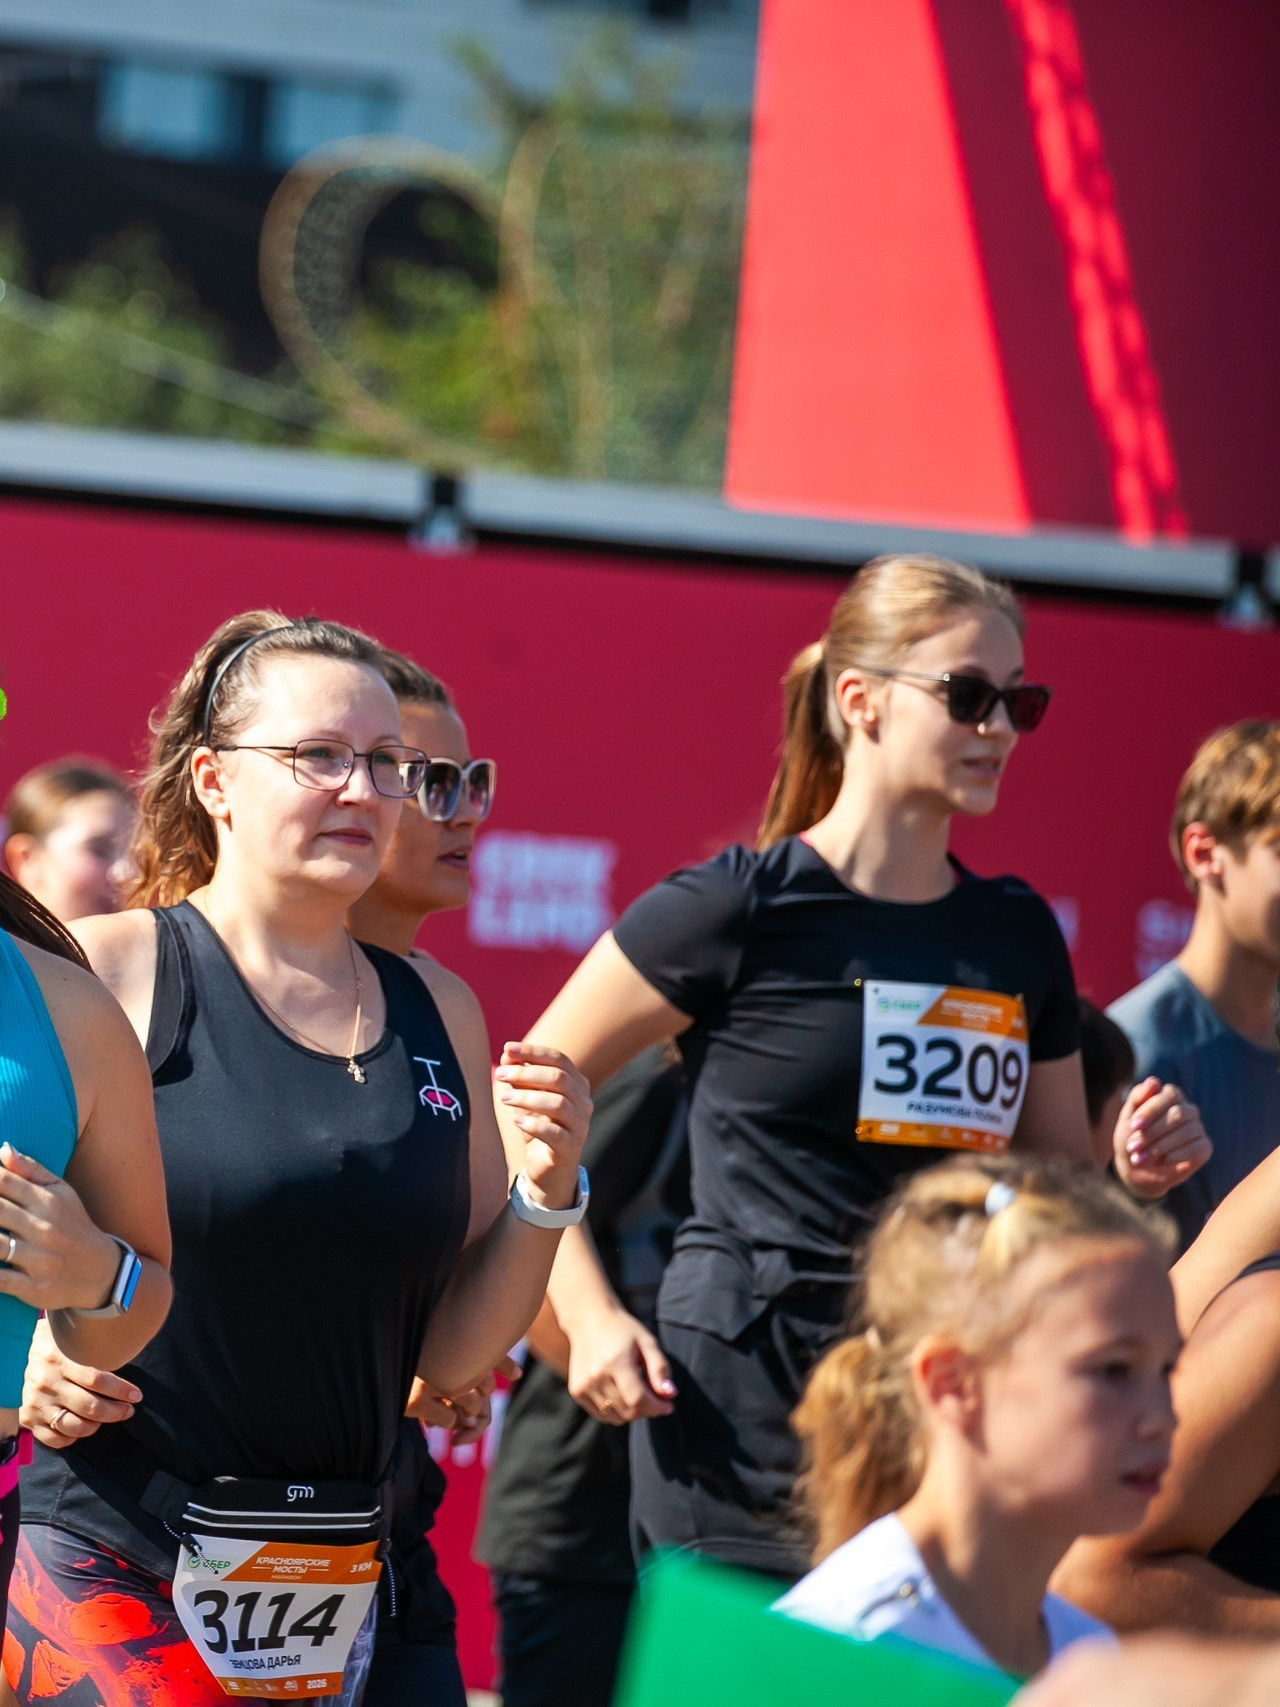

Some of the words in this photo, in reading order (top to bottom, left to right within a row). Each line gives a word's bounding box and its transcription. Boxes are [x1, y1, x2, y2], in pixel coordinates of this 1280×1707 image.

[874, 1033, 1022, 1111] 3209
[256, 1556, 331, 1568] КРАСНОЯРСКИЕ
[350, 1564, 358, 1573] 3
[358, 1562, 373, 1573] КМ
[272, 1565, 308, 1574] МОСТЫ
[194, 1589, 346, 1655] 3114
[267, 1654, 302, 1671] ДАРЬЯ
[307, 1678, 327, 1689] 2026
